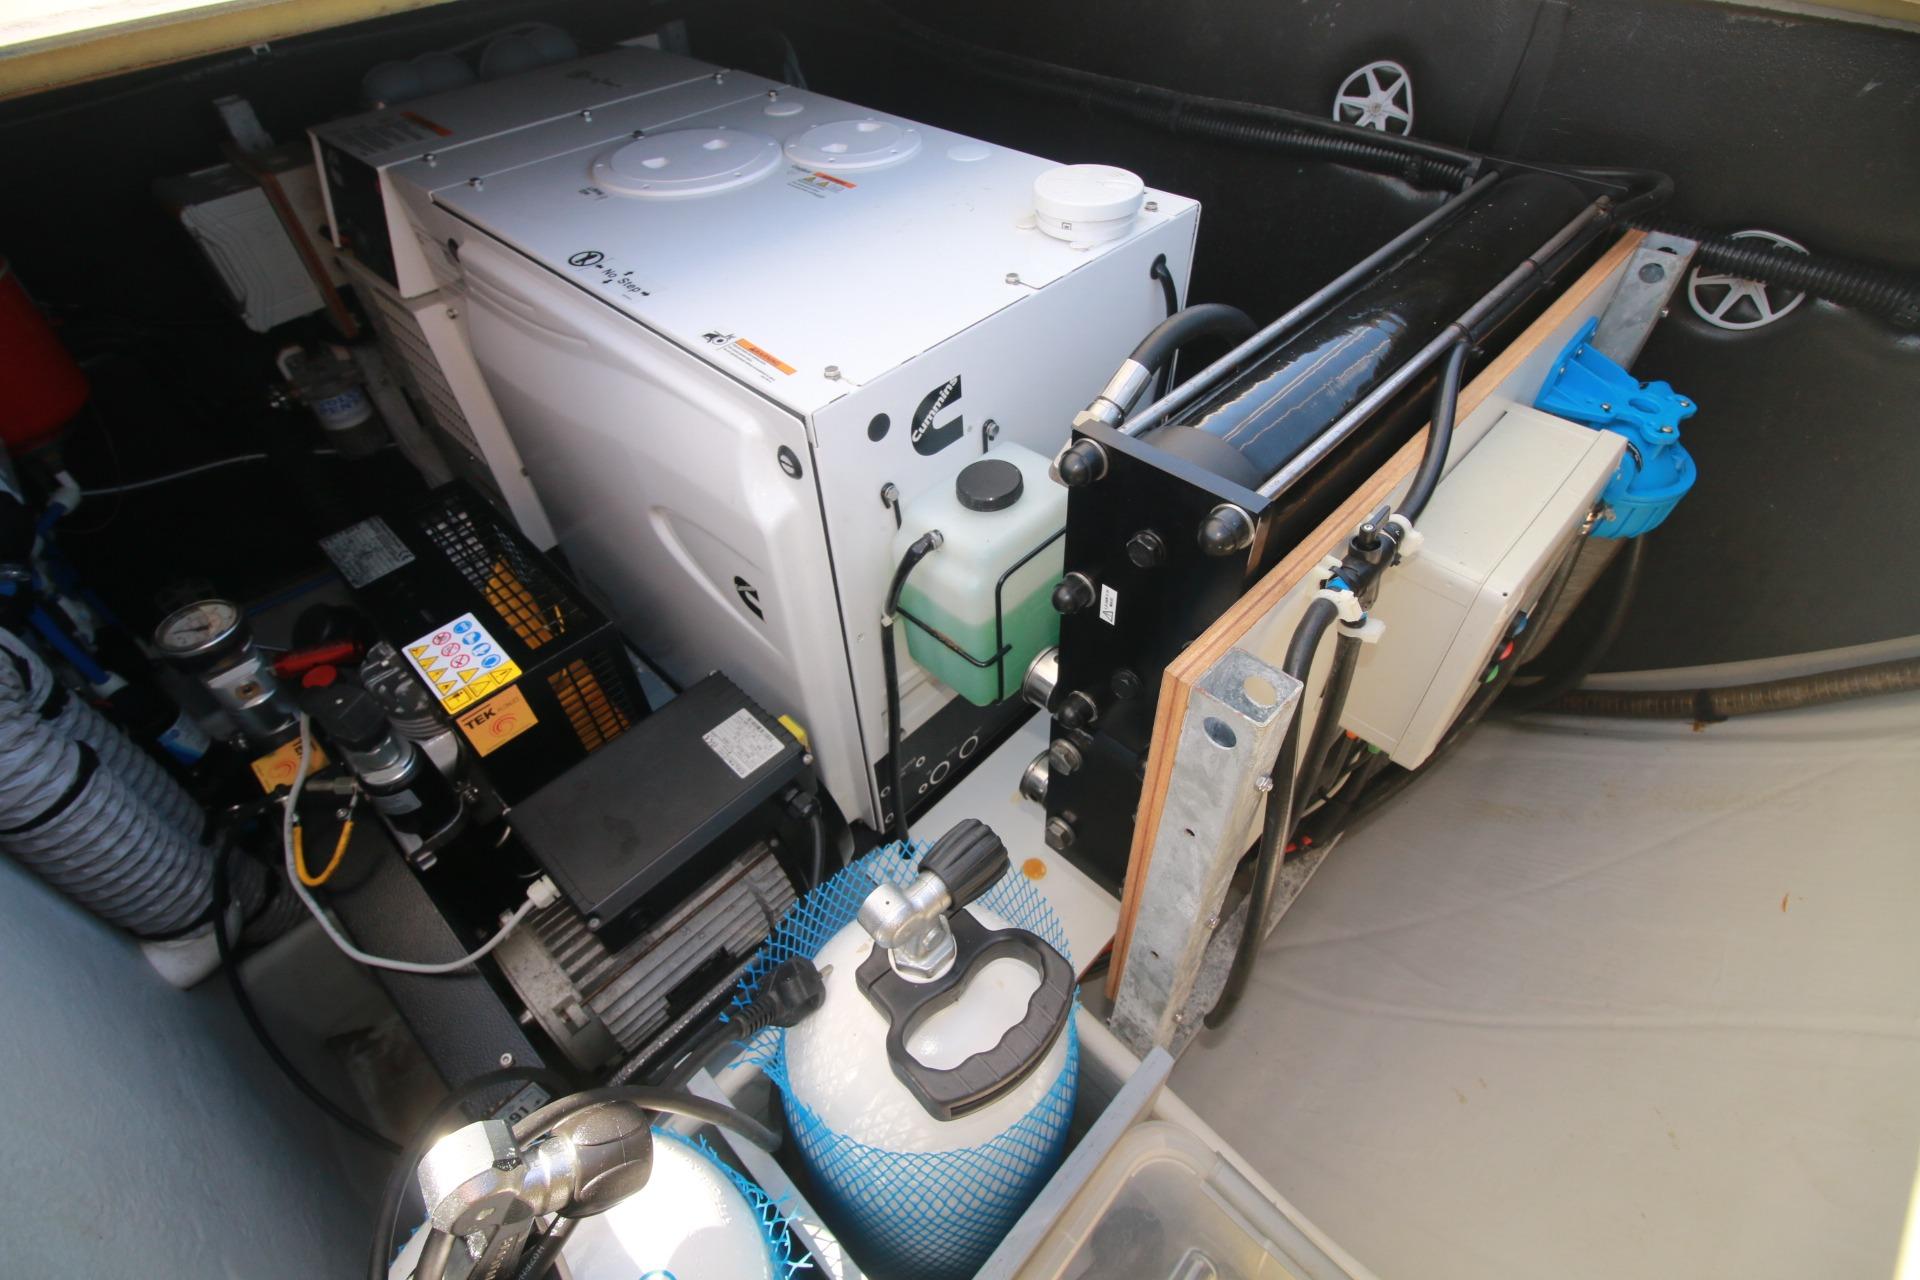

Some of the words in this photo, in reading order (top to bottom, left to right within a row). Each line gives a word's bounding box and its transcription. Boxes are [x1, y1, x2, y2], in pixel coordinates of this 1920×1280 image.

[602, 268, 618, 279] No
[617, 277, 641, 293] Step
[911, 377, 958, 443] Cummins
[464, 707, 497, 730] TEK
